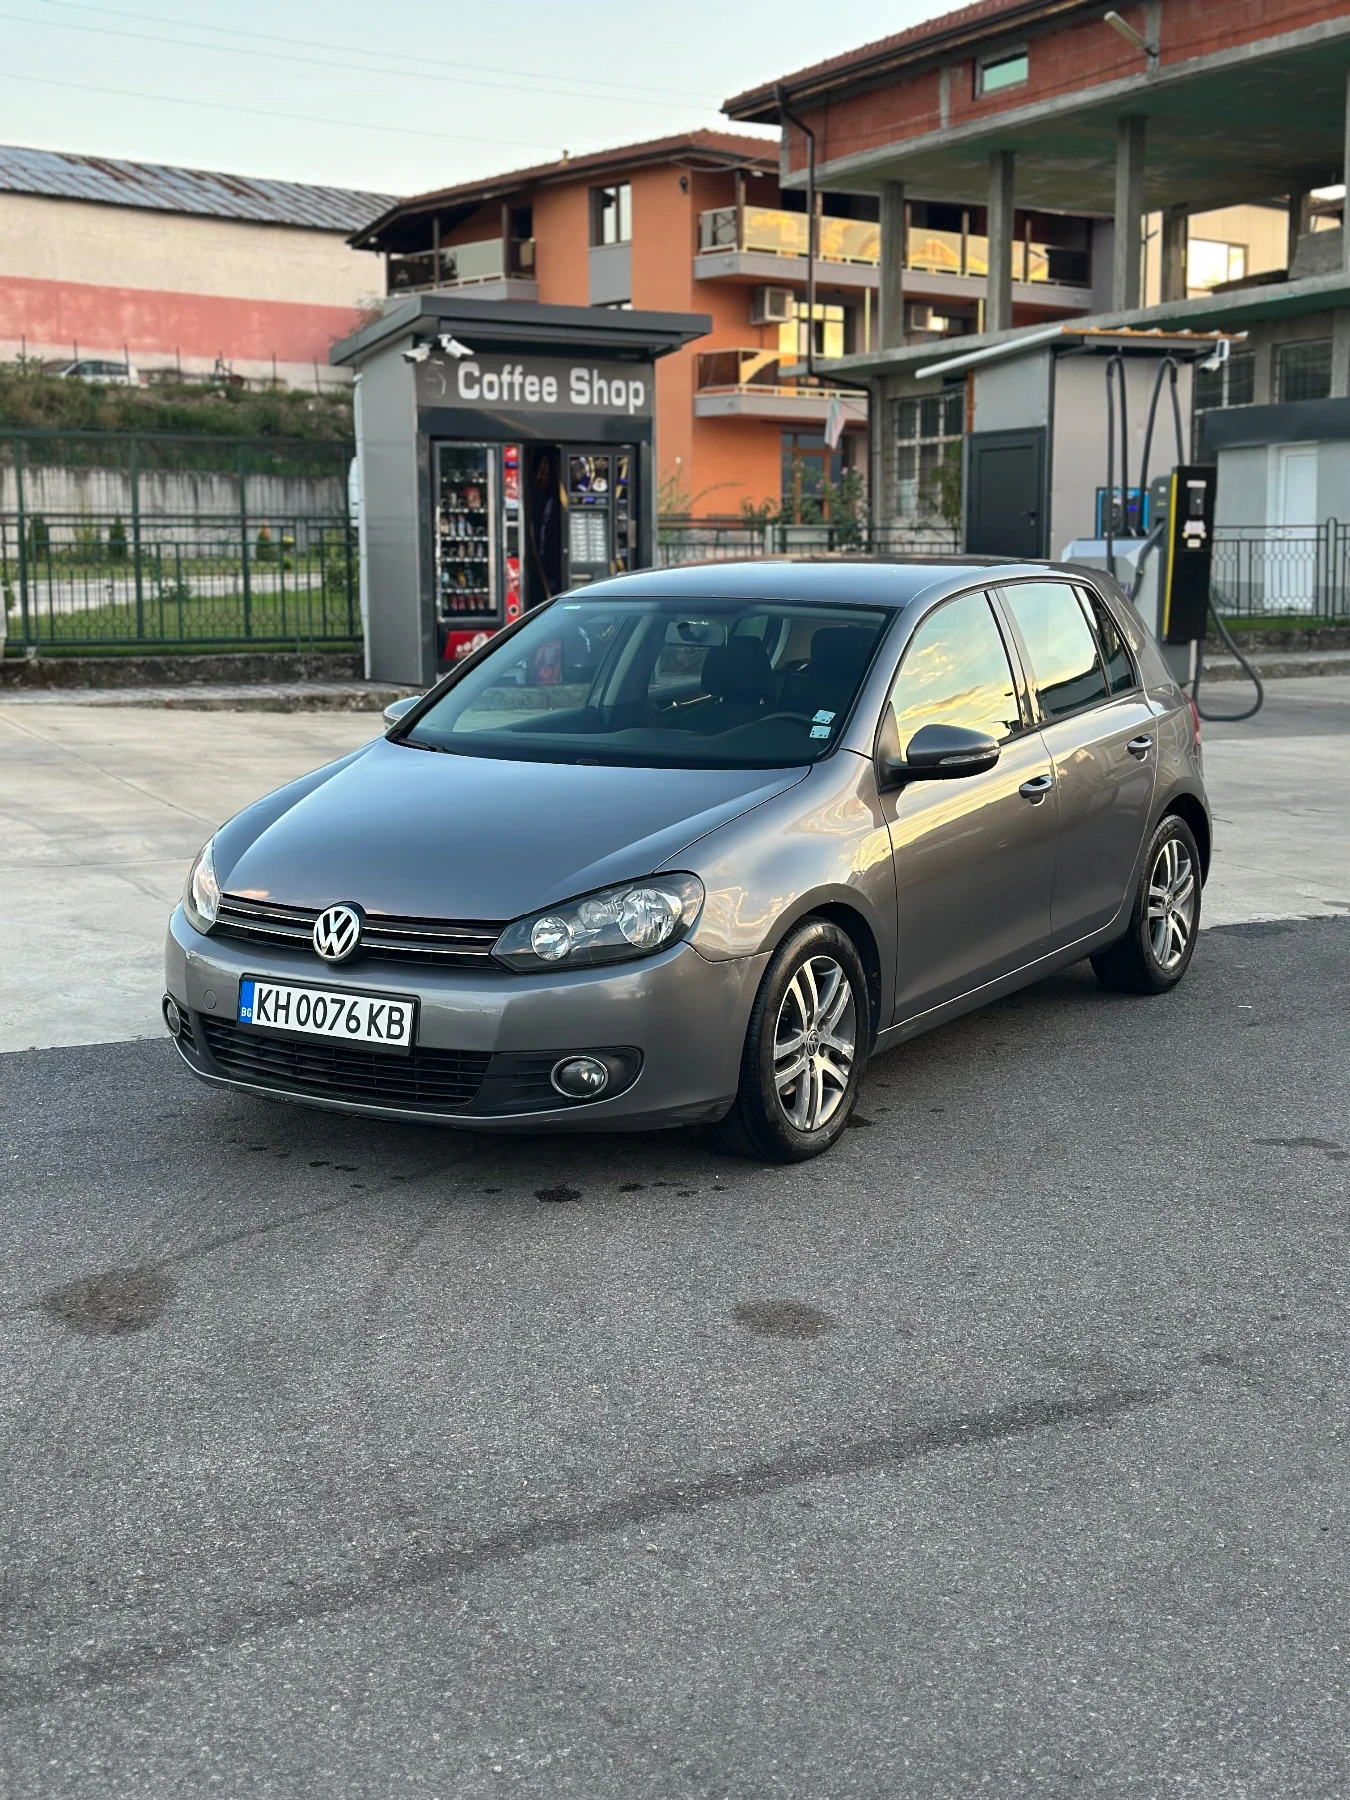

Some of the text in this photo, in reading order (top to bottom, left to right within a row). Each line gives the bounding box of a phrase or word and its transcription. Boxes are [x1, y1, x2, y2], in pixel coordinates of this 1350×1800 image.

[458, 361, 645, 414] Coffee Shop
[241, 1007, 252, 1018] BG
